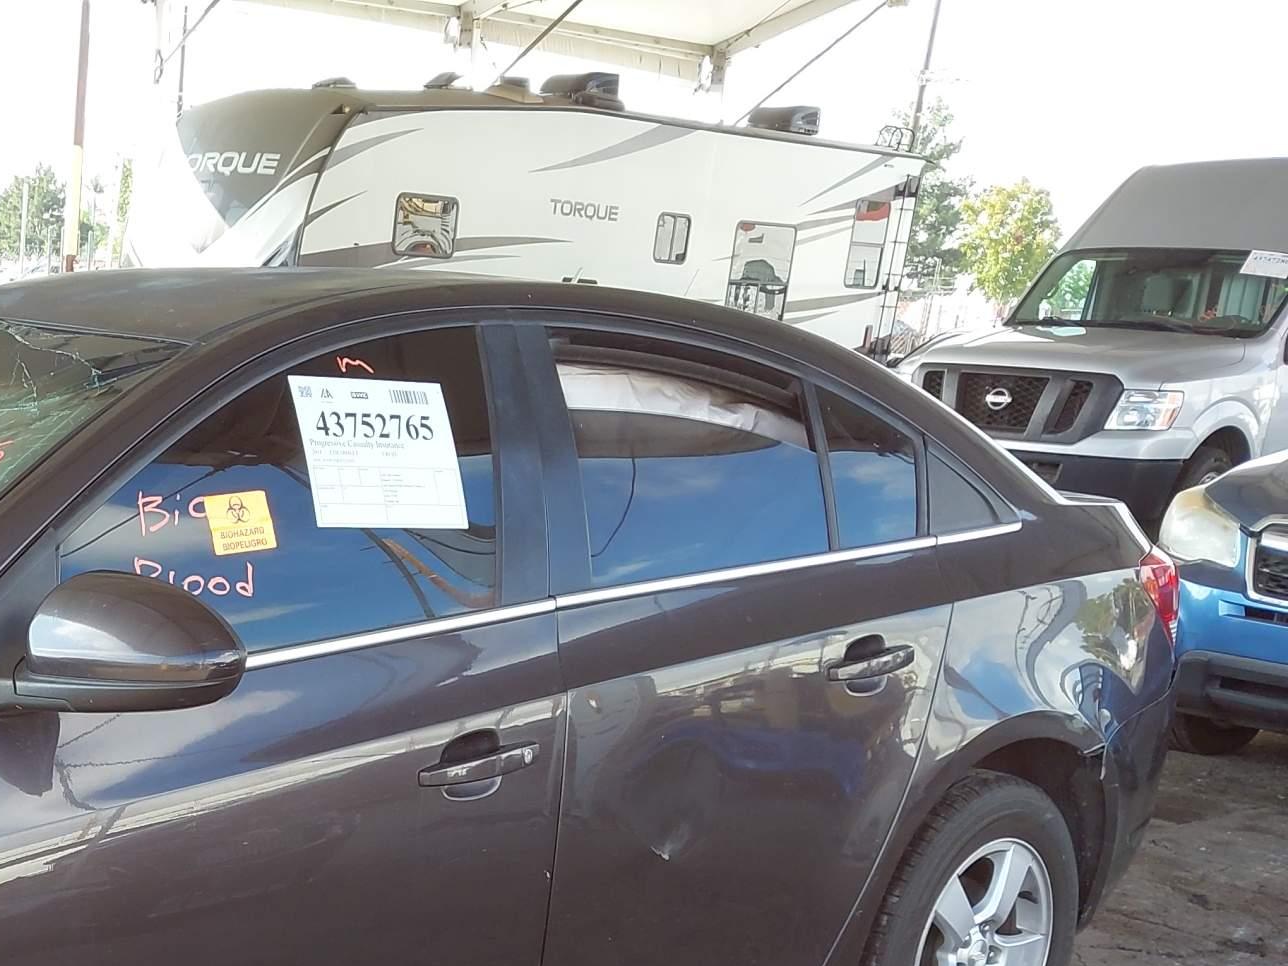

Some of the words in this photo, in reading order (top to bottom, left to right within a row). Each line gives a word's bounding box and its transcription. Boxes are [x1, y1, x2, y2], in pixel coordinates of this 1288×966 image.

[187, 152, 280, 176] ORQUE
[550, 198, 619, 221] TORQUE
[316, 411, 434, 440] 43752765
[220, 526, 265, 539] BIOHAZARD
[222, 538, 268, 551] BIOPELIGRO
